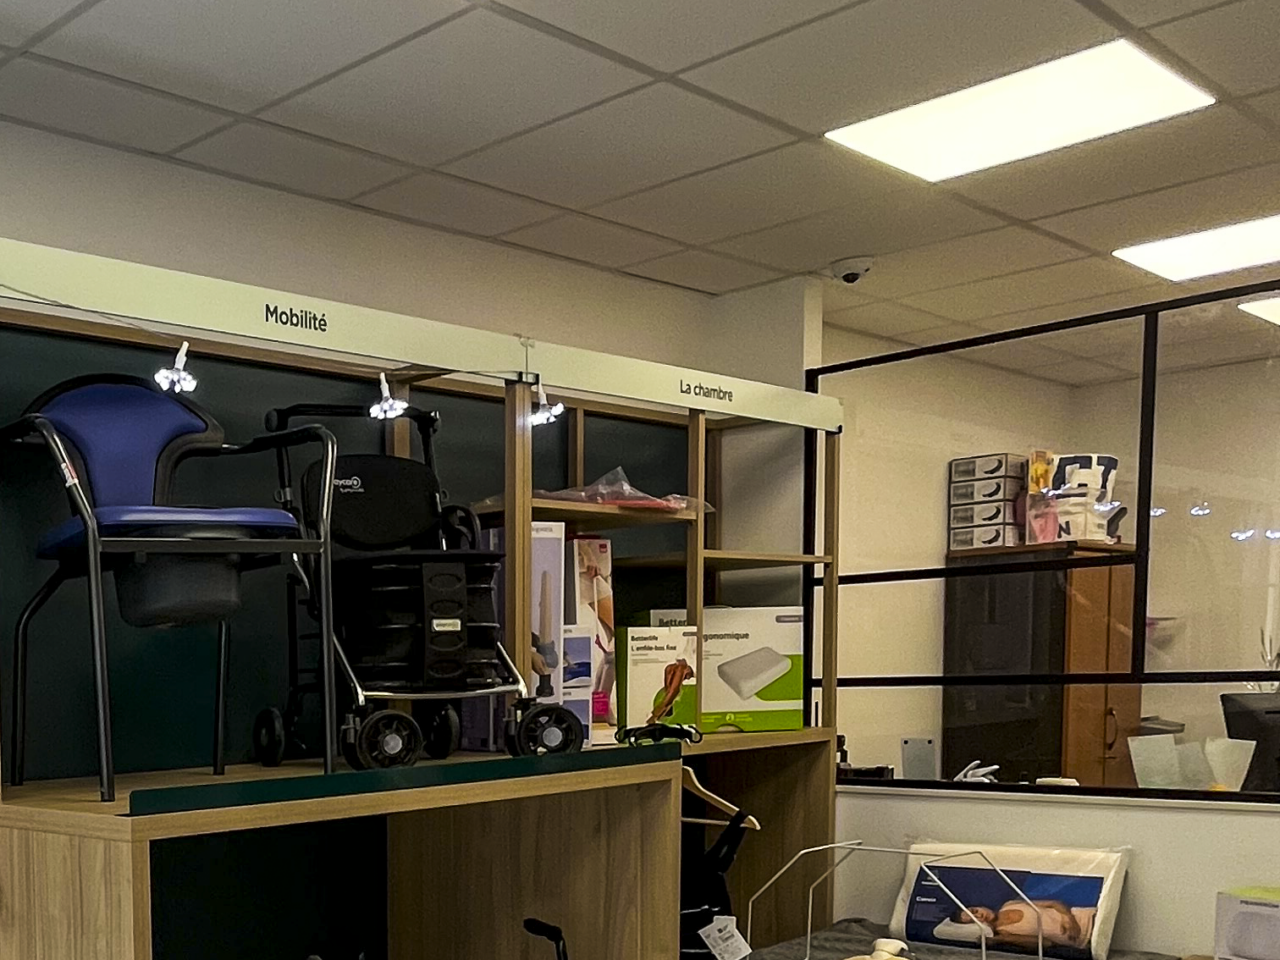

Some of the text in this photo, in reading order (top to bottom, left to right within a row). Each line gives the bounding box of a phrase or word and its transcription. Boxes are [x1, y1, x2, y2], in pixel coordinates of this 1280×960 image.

[265, 303, 327, 332] Mobilité
[680, 379, 733, 402] La chambre
[703, 632, 750, 643] gonomique
